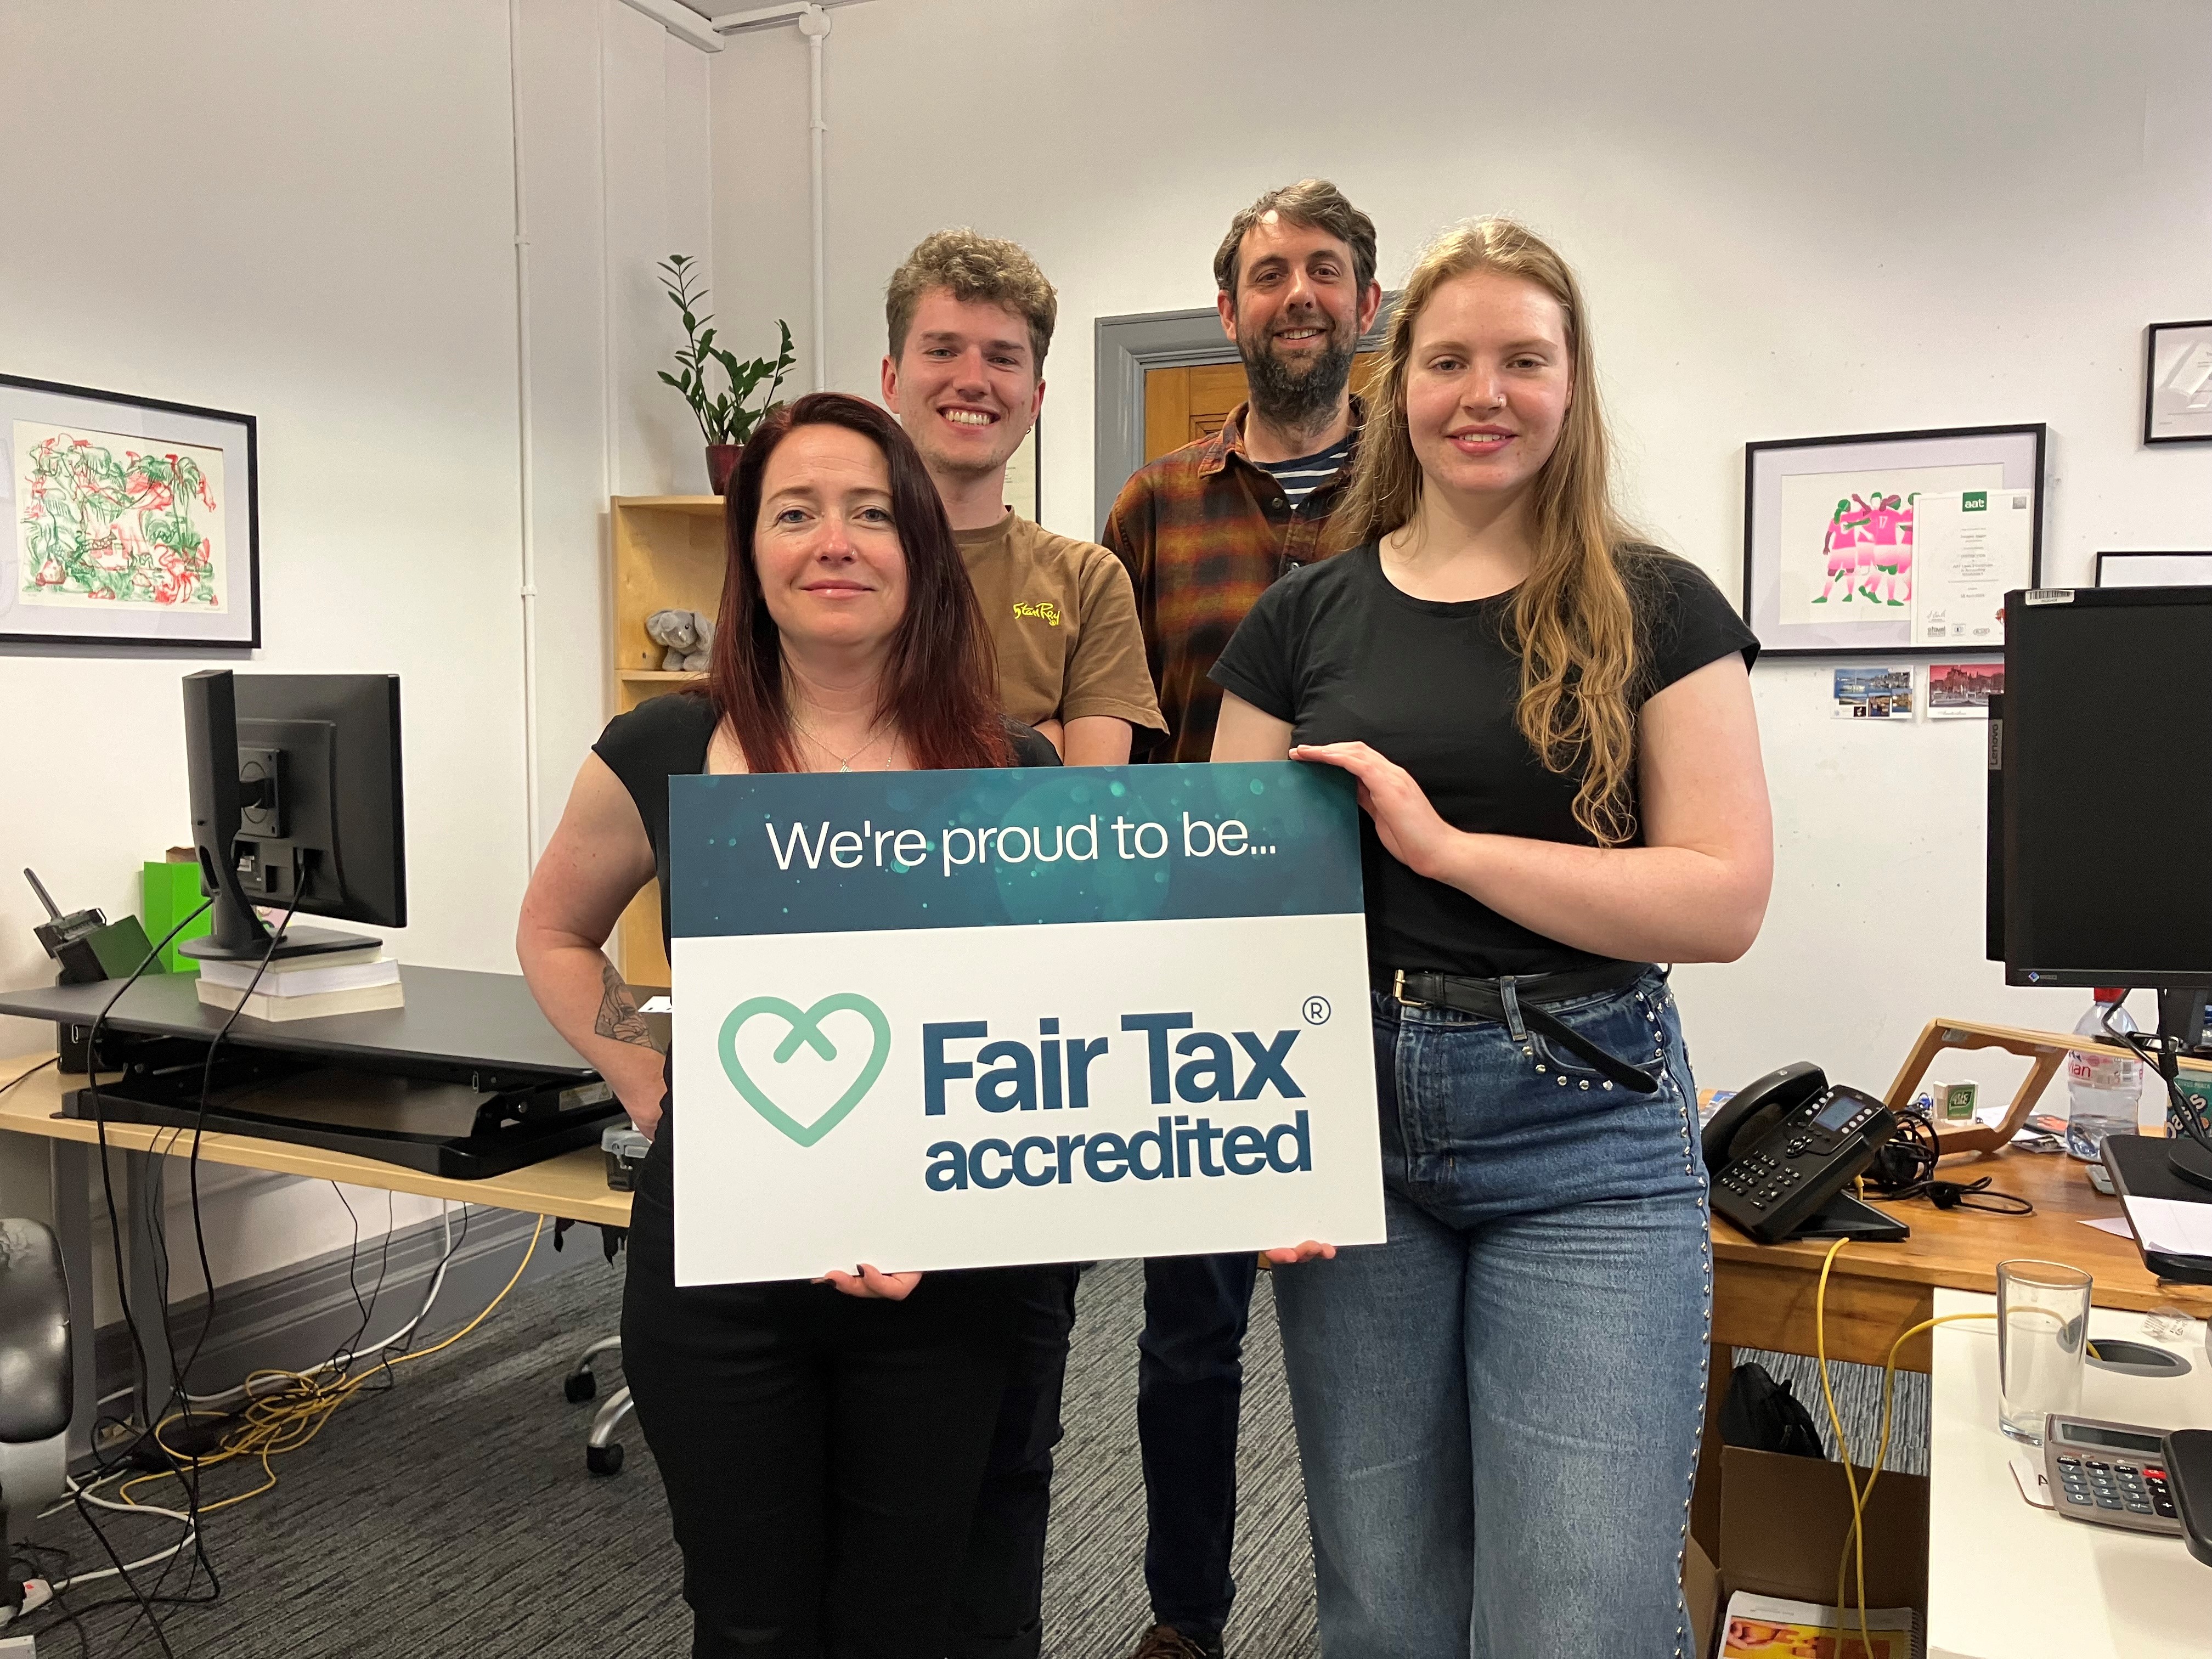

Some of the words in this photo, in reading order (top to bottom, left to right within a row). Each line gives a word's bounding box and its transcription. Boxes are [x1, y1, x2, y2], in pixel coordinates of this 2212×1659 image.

[1879, 516, 1888, 529] 17
[1965, 498, 1984, 509] aat
[765, 820, 927, 870] We're
[943, 814, 1098, 877] proud
[1110, 816, 1168, 859] to
[1183, 811, 1276, 857] be...
[922, 1017, 1109, 1116] Fair
[1120, 1012, 1306, 1105] Tax
[925, 1109, 1312, 1192] accredited
